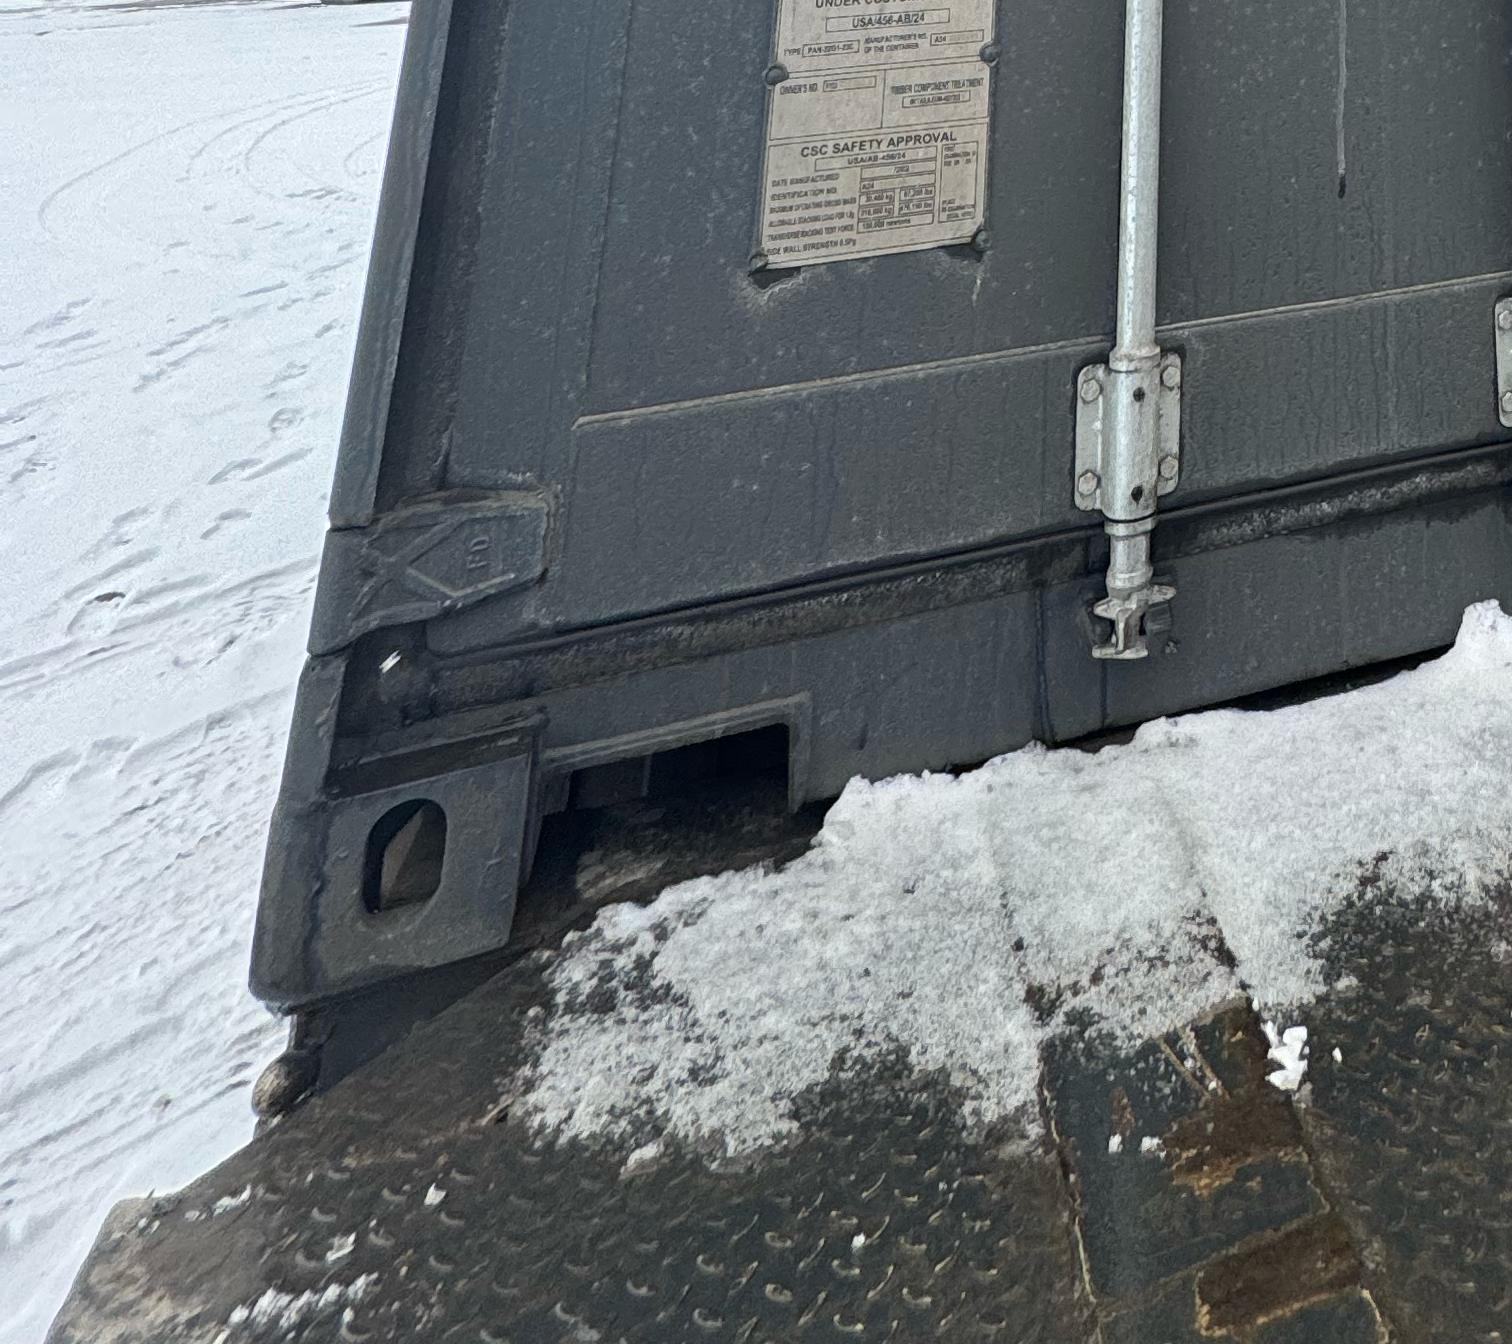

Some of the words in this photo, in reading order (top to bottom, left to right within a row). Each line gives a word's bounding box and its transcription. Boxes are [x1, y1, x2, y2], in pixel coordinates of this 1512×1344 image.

[800, 144, 828, 158] CSC
[832, 139, 883, 155] SAFETY
[887, 131, 957, 148] APPROVAL
